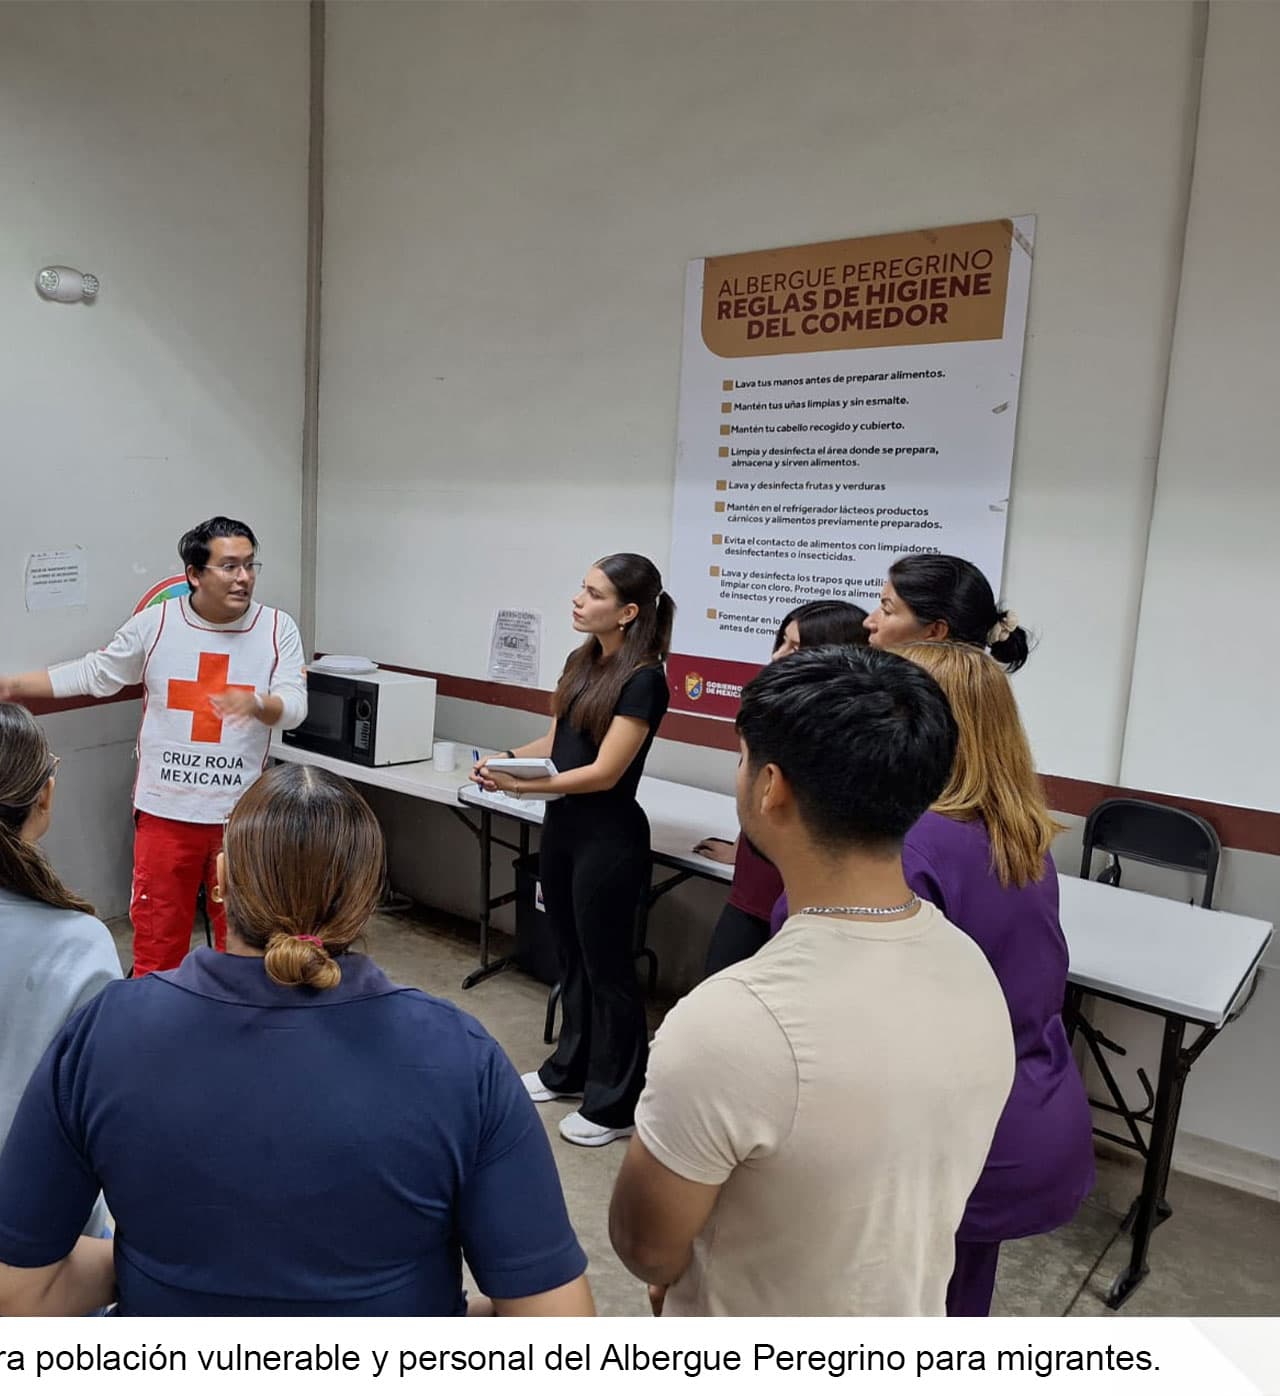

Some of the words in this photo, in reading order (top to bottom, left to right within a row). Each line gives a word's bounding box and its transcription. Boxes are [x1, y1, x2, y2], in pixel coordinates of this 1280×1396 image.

[719, 267, 836, 297] ALBERGUE
[842, 248, 992, 284] PEREGRINO
[717, 290, 817, 320] REGLAS
[824, 286, 860, 310] DE
[866, 272, 992, 306] HIGIENE
[747, 319, 795, 340] DEL
[801, 302, 948, 335] COMEDOR
[736, 380, 756, 388] Lava
[774, 378, 803, 386] manos
[805, 376, 830, 384] antes
[833, 374, 844, 382] de
[846, 373, 889, 384] preparar
[890, 370, 945, 380] alimentos.
[734, 402, 766, 410] Mantén
[784, 400, 806, 409] uñas
[807, 398, 840, 409] limpias
[842, 400, 848, 409] y
[850, 397, 864, 406] sin
[866, 396, 909, 406] esmalte.
[731, 424, 764, 433] Mantén
[766, 424, 775, 432] tu
[776, 424, 808, 432] cabello
[810, 422, 850, 433] recogido
[852, 424, 858, 432] y
[860, 421, 904, 430] cubierto.
[731, 448, 760, 456] Limpia
[768, 446, 816, 456] desinfecta
[818, 446, 826, 455] el
[827, 446, 848, 454] área
[849, 445, 880, 454] donde
[732, 458, 772, 467] almacena
[774, 460, 780, 469] y
[782, 458, 808, 467] sirven
[810, 458, 860, 467] alimentos.
[728, 480, 748, 490] Lava
[750, 482, 756, 491] y
[757, 481, 804, 490] desinfecta
[806, 481, 833, 490] frutas
[835, 484, 841, 492] y
[843, 482, 886, 490] verduras
[726, 503, 760, 512] Mantén
[773, 504, 781, 512] el
[782, 504, 838, 514] refrigerador
[840, 504, 874, 514] lácteos
[876, 507, 929, 517] productos
[728, 514, 764, 522] cárnicos
[765, 517, 770, 525] y
[772, 516, 816, 525] alimentos
[818, 517, 879, 527] previamente
[880, 520, 942, 530] preparados.
[724, 536, 746, 544] Evita
[748, 536, 755, 545] el
[756, 538, 796, 546] contacto
[797, 539, 808, 547] de
[810, 540, 856, 550] alimentos
[724, 547, 788, 558] desinfectantes
[798, 550, 856, 561] insecticidas.
[721, 568, 742, 577] Lava
[742, 572, 748, 580] y
[750, 570, 796, 581] desinfecta
[797, 574, 810, 582] los
[812, 576, 842, 585] trapos
[844, 578, 862, 587] que
[720, 580, 749, 589] limpiar
[768, 583, 792, 592] cloro.
[794, 584, 831, 596] Protege
[832, 588, 846, 596] los
[848, 589, 880, 598] alimen
[732, 592, 767, 600] insectos
[768, 596, 774, 604] y
[718, 612, 758, 623] Fomentar
[760, 616, 771, 624] en
[720, 624, 742, 632] antes
[756, 628, 778, 636] com
[706, 681, 742, 692] GOBIERNO
[162, 751, 201, 767] CRUZ
[205, 755, 244, 769] ROJA
[160, 768, 242, 785] MEXICANA
